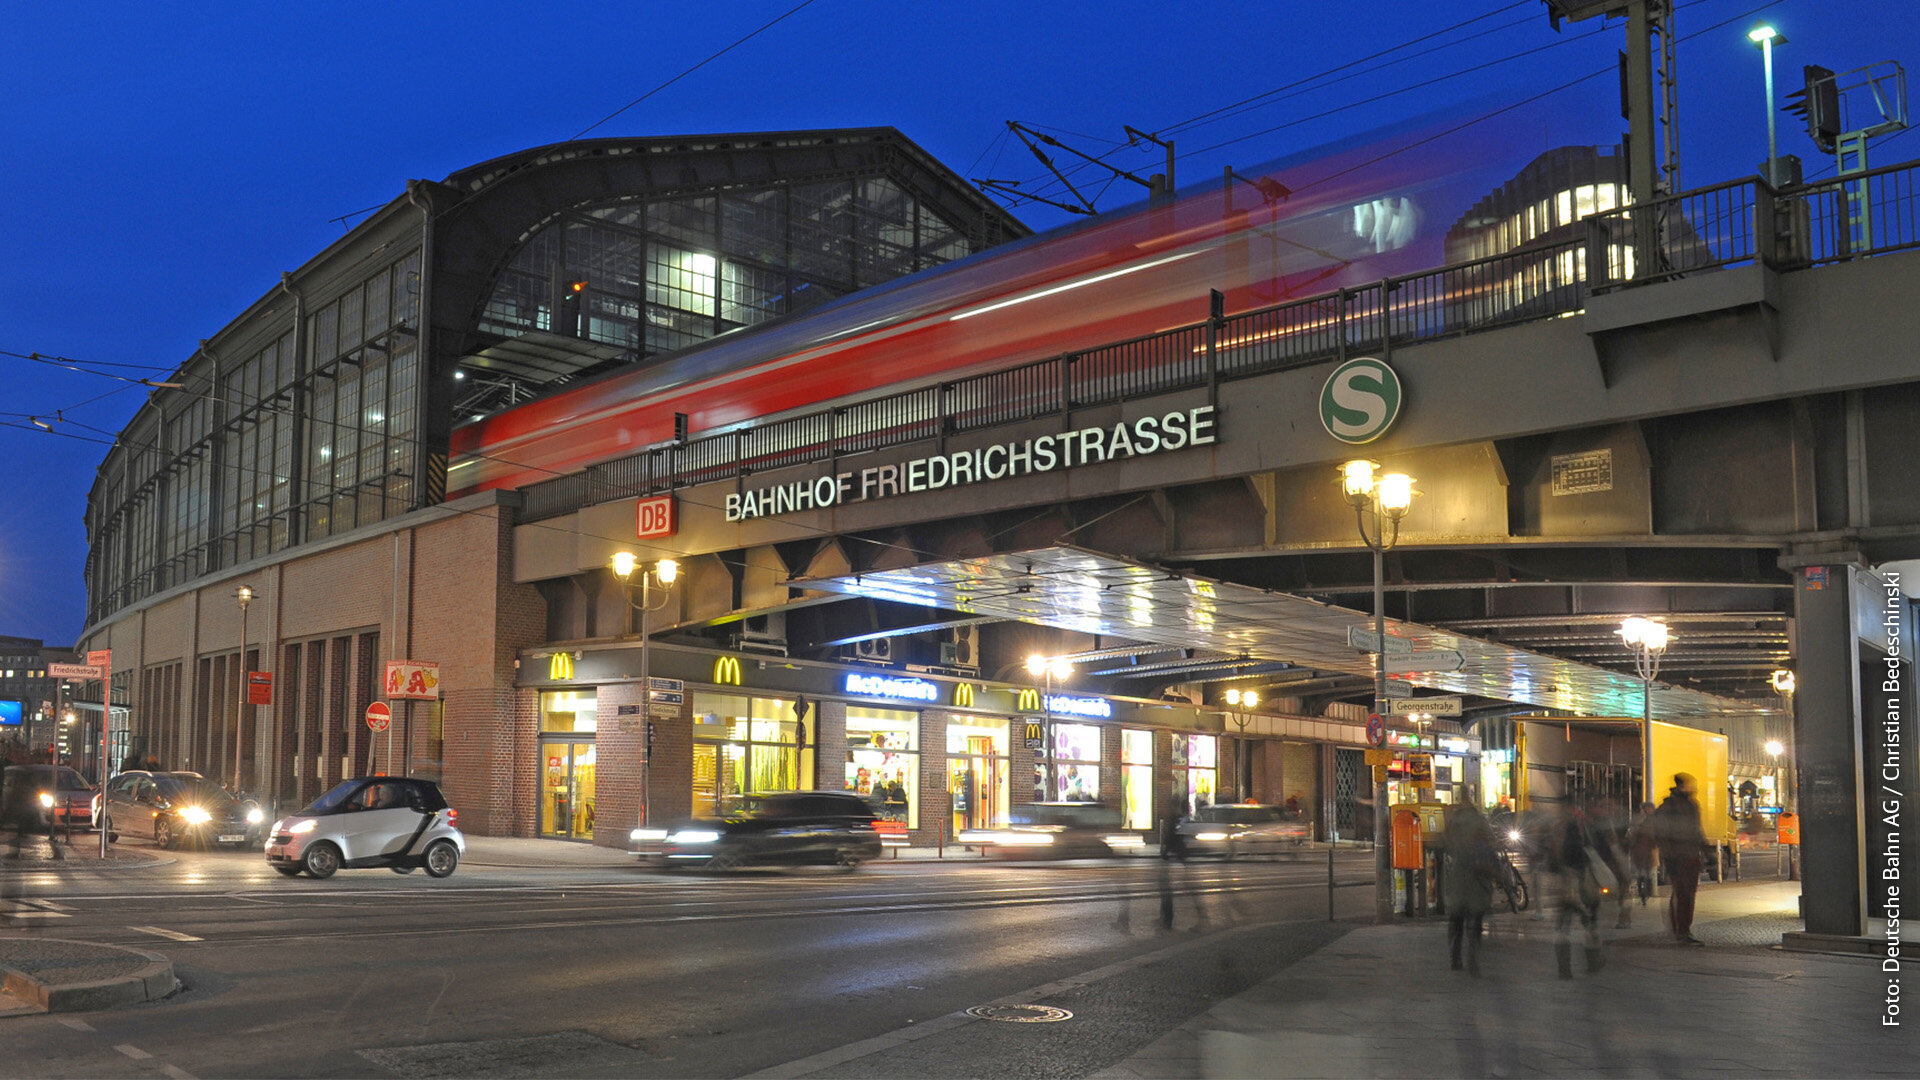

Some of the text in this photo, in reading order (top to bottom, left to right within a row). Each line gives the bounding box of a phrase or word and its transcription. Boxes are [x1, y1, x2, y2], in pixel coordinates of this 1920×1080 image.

[1331, 365, 1387, 437] S
[725, 405, 1215, 523] BAHNHOF FRIEDRICHSTRASSE
[641, 502, 668, 533] DB
[53, 665, 99, 676] Friedrichstraße
[1396, 701, 1455, 713] Georgenstraße
